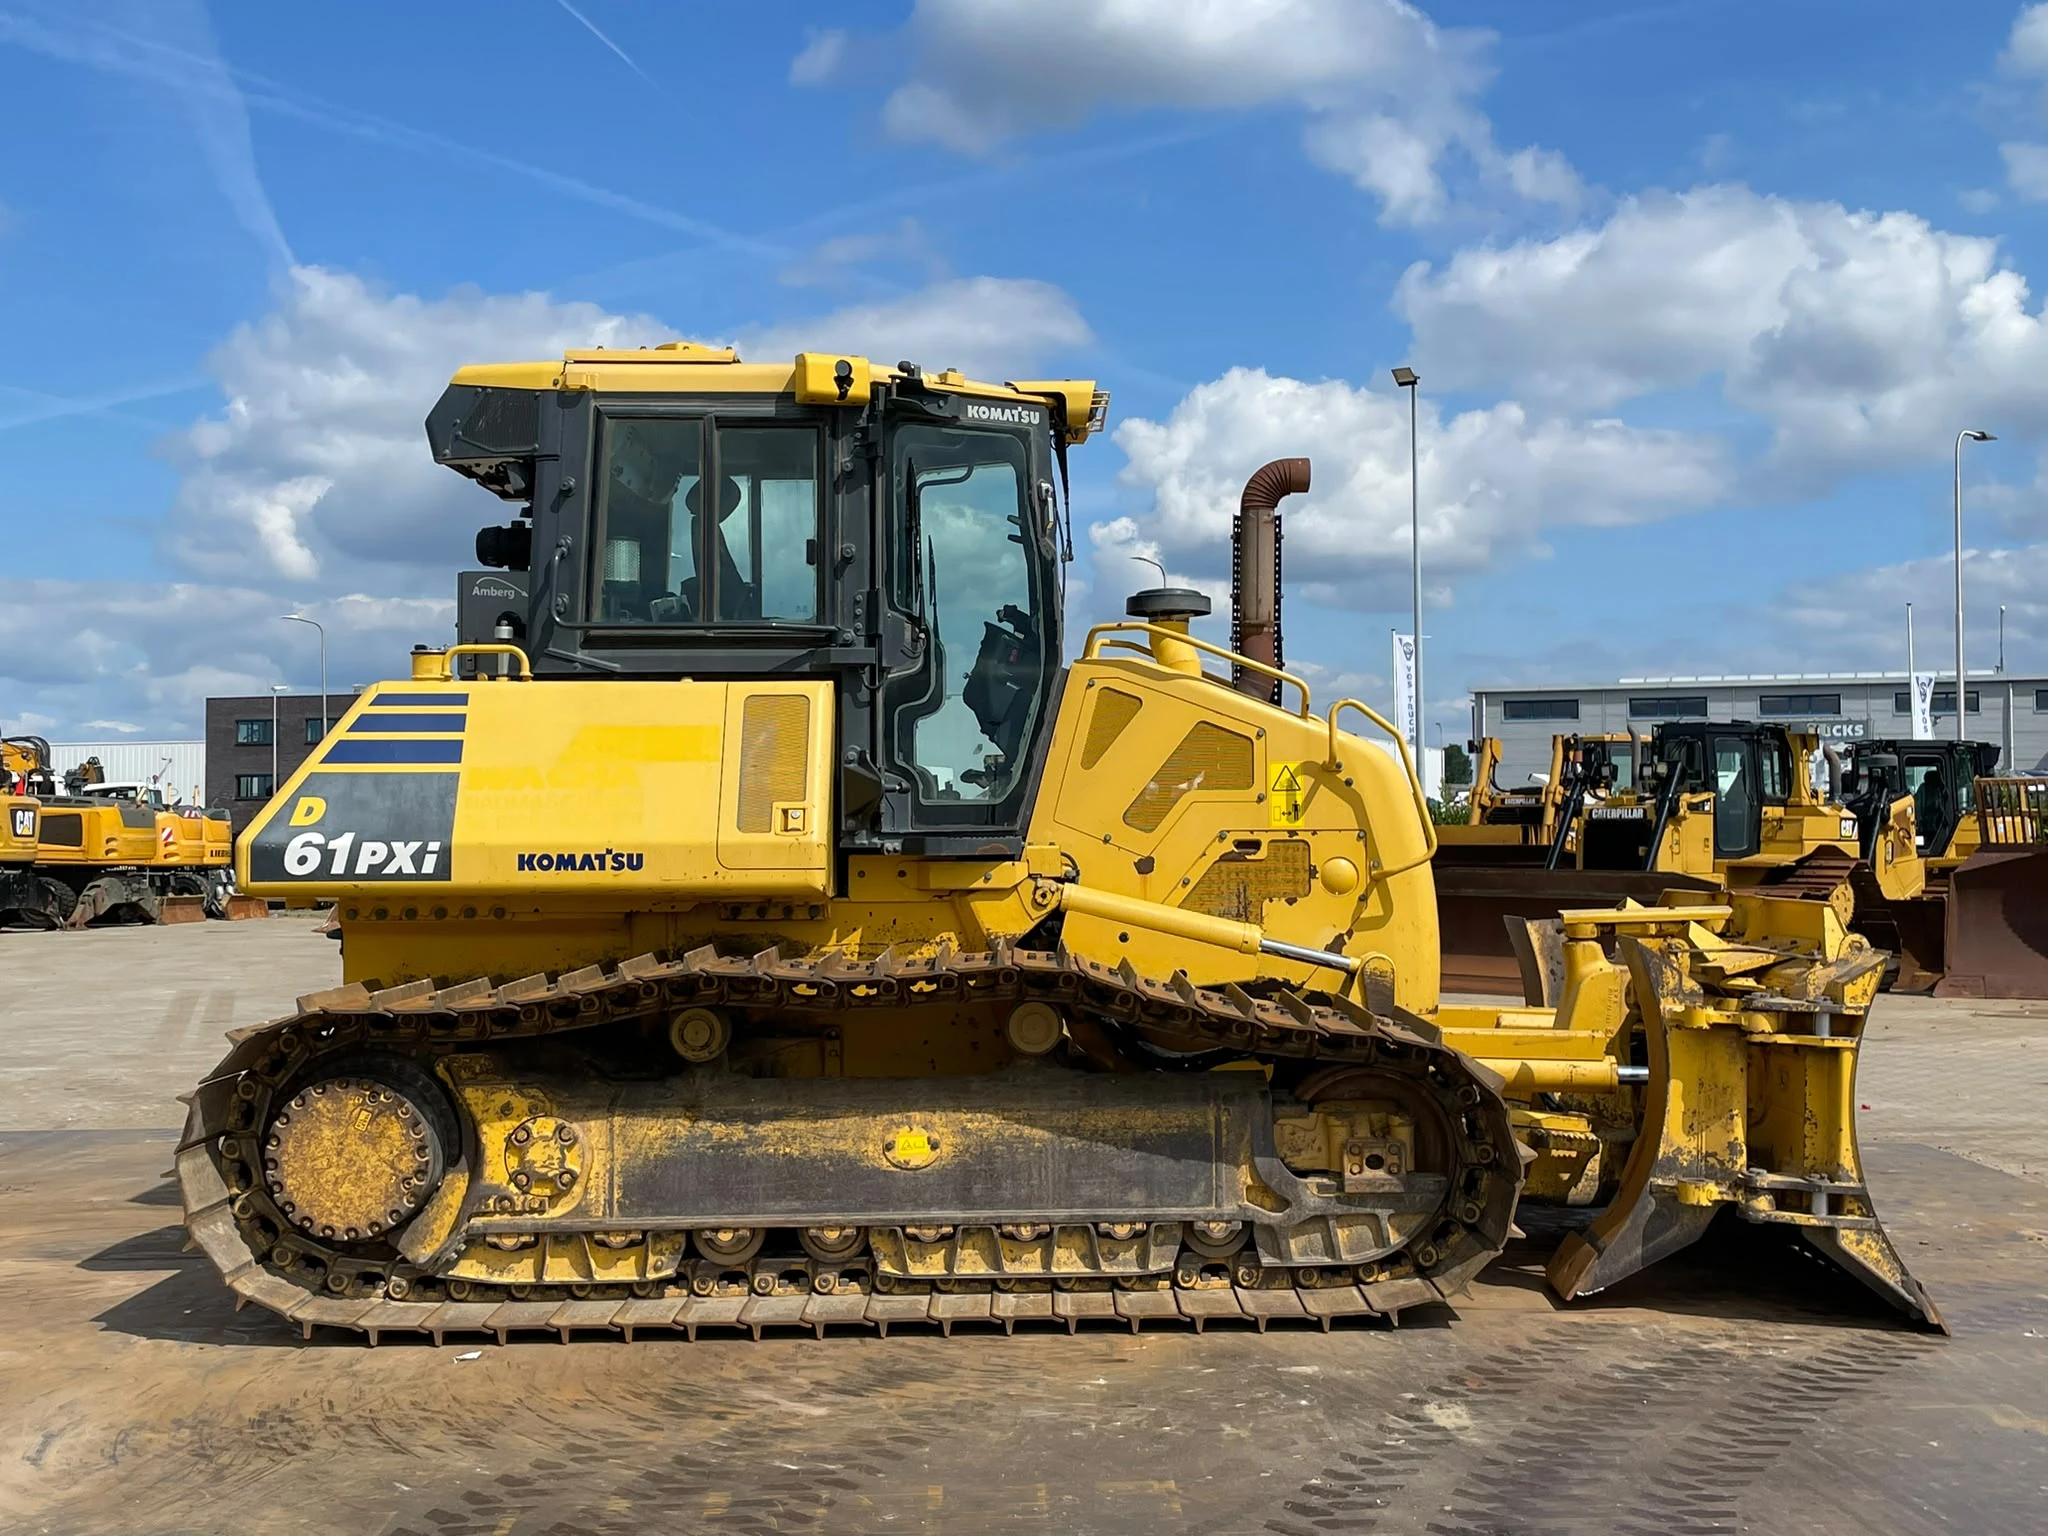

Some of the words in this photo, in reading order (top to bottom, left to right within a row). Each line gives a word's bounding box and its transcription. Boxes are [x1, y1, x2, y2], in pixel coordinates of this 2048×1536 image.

[966, 405, 1040, 425] KOMATSU
[472, 586, 515, 600] Amberg
[16, 810, 34, 836] CAT
[288, 797, 327, 827] D
[1592, 808, 1644, 819] CATERPILLAR
[1841, 819, 1854, 837] CAT
[284, 831, 441, 876] 61PXi
[517, 848, 644, 872] KOMATSU
